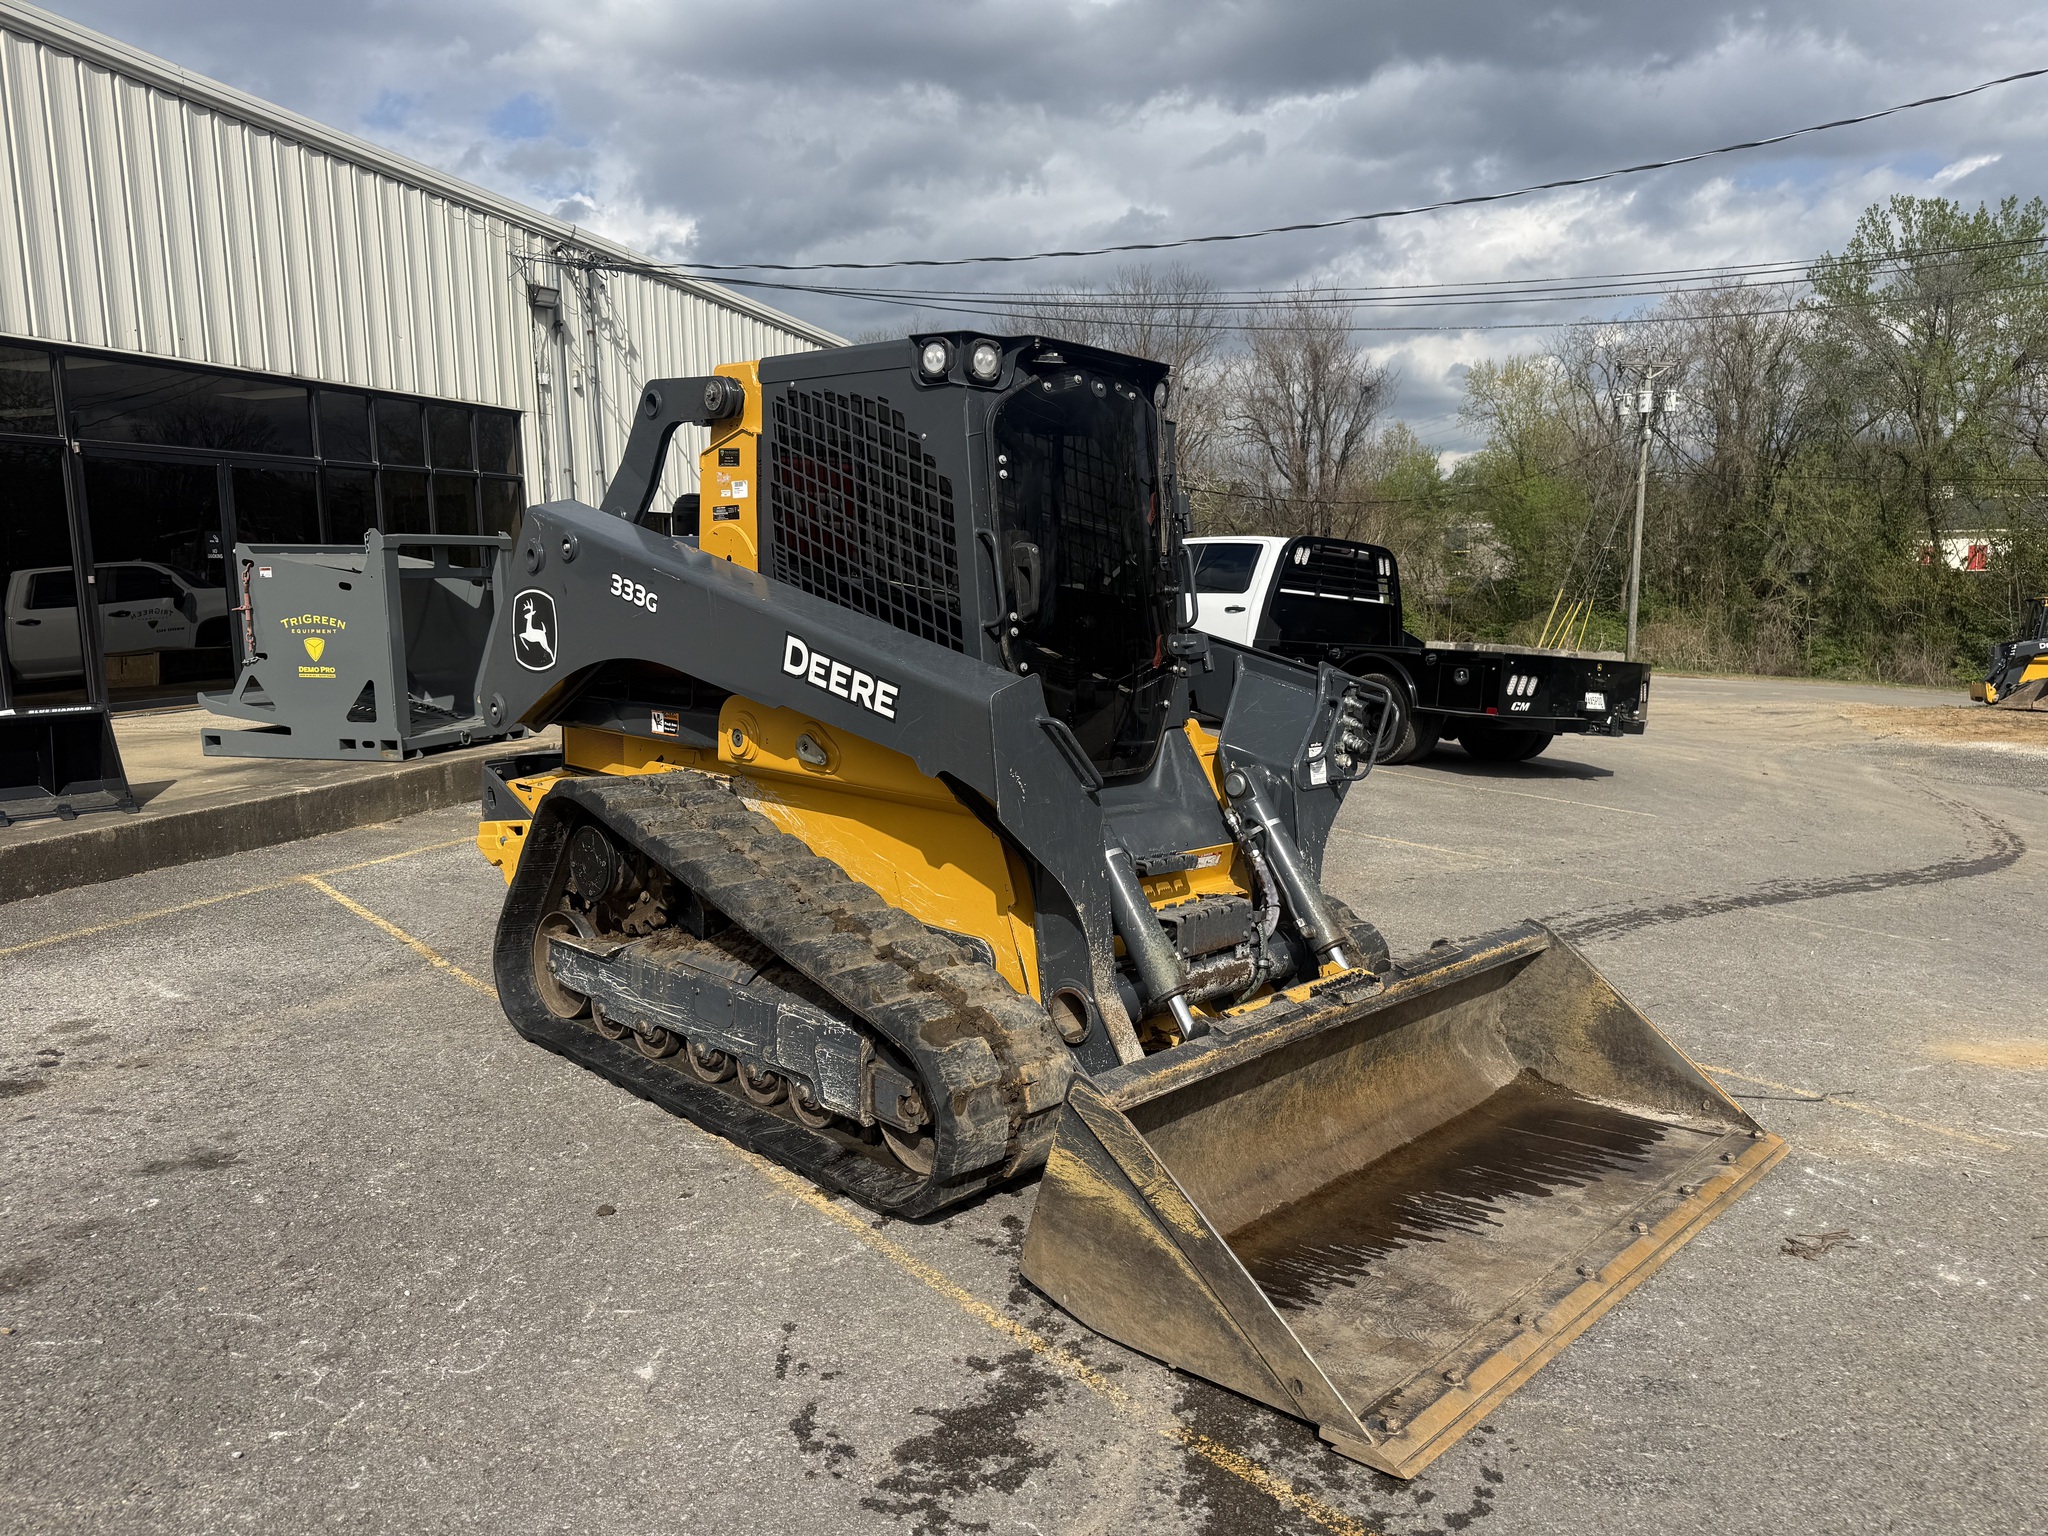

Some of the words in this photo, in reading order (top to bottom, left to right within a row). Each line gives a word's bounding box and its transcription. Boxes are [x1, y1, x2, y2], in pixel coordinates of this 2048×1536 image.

[610, 573, 658, 613] 333G
[280, 614, 346, 630] TRIGREEN
[783, 634, 899, 720] DEERE
[1510, 701, 1531, 711] CM
